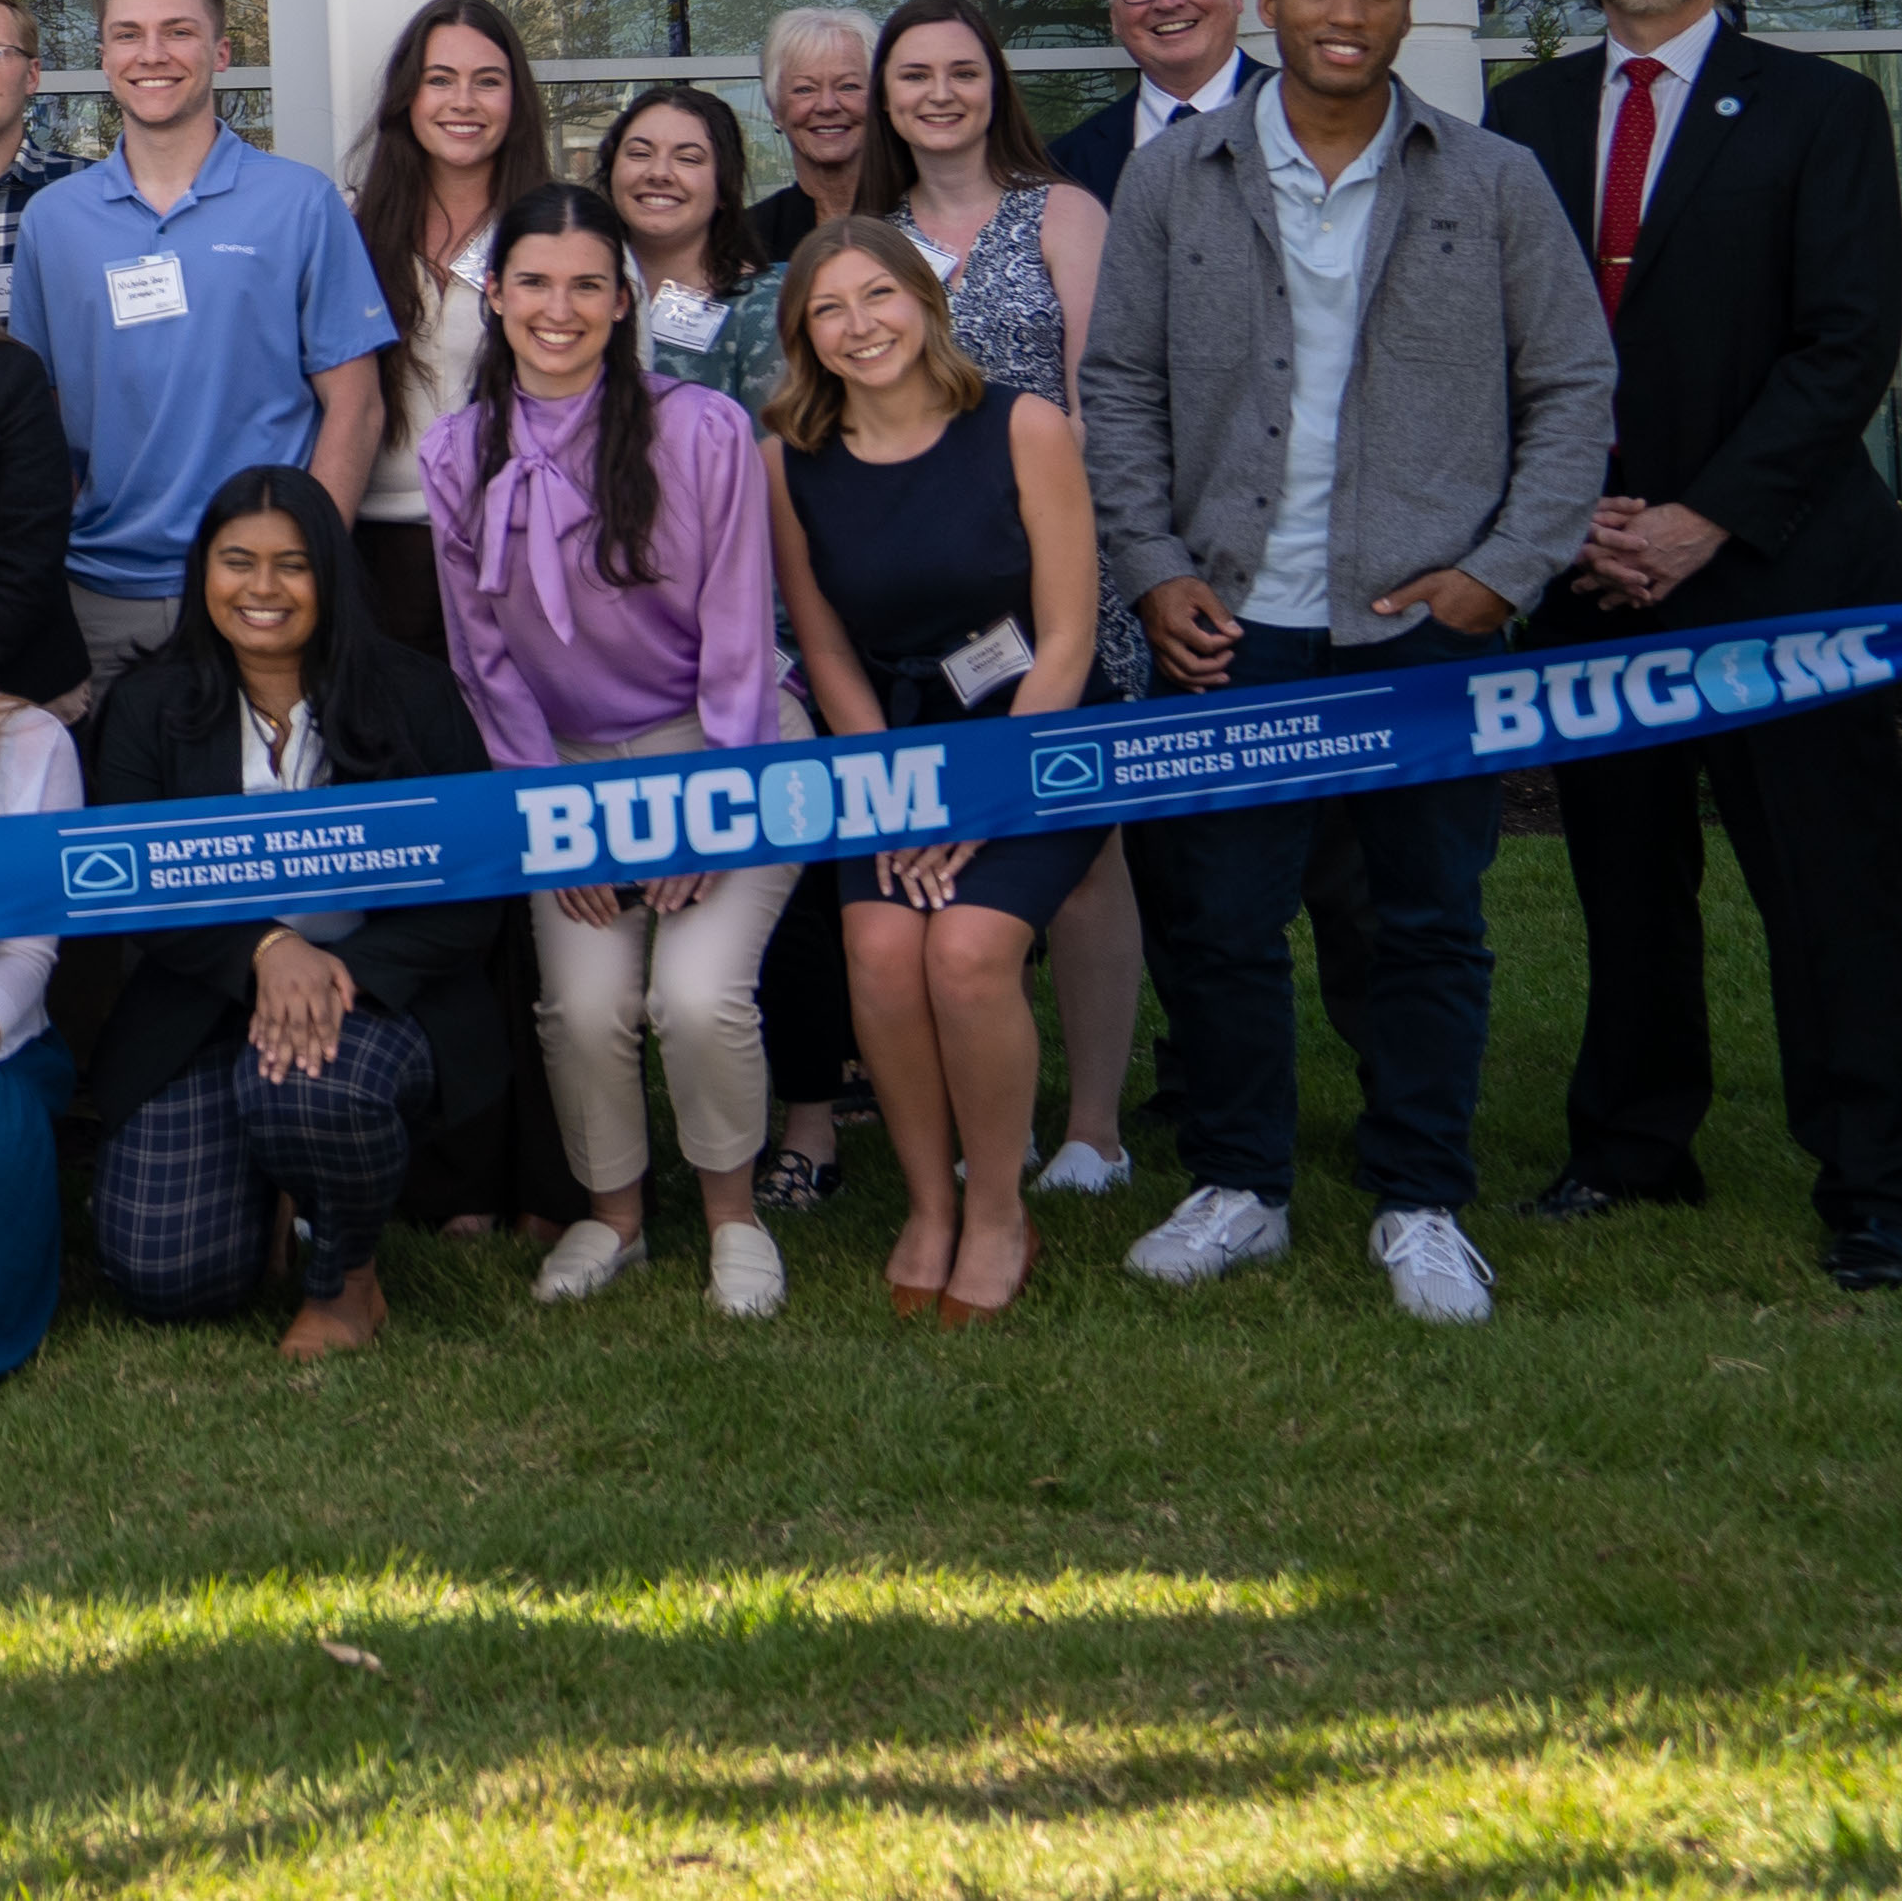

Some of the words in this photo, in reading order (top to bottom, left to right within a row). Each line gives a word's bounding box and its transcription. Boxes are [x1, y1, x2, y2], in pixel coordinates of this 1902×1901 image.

[1467, 624, 1894, 755] BUCOM
[1113, 729, 1215, 759] BAPTIST
[1225, 714, 1321, 745] HEALTH
[1115, 756, 1234, 785] SCIENCES
[1241, 730, 1394, 768] UNIVERSITY
[515, 744, 950, 874] BUCOM
[147, 835, 255, 862] BAPTIST
[264, 825, 365, 853] HEALTH
[150, 861, 276, 889] SCIENCES
[282, 844, 442, 878] UNIVERSITY
